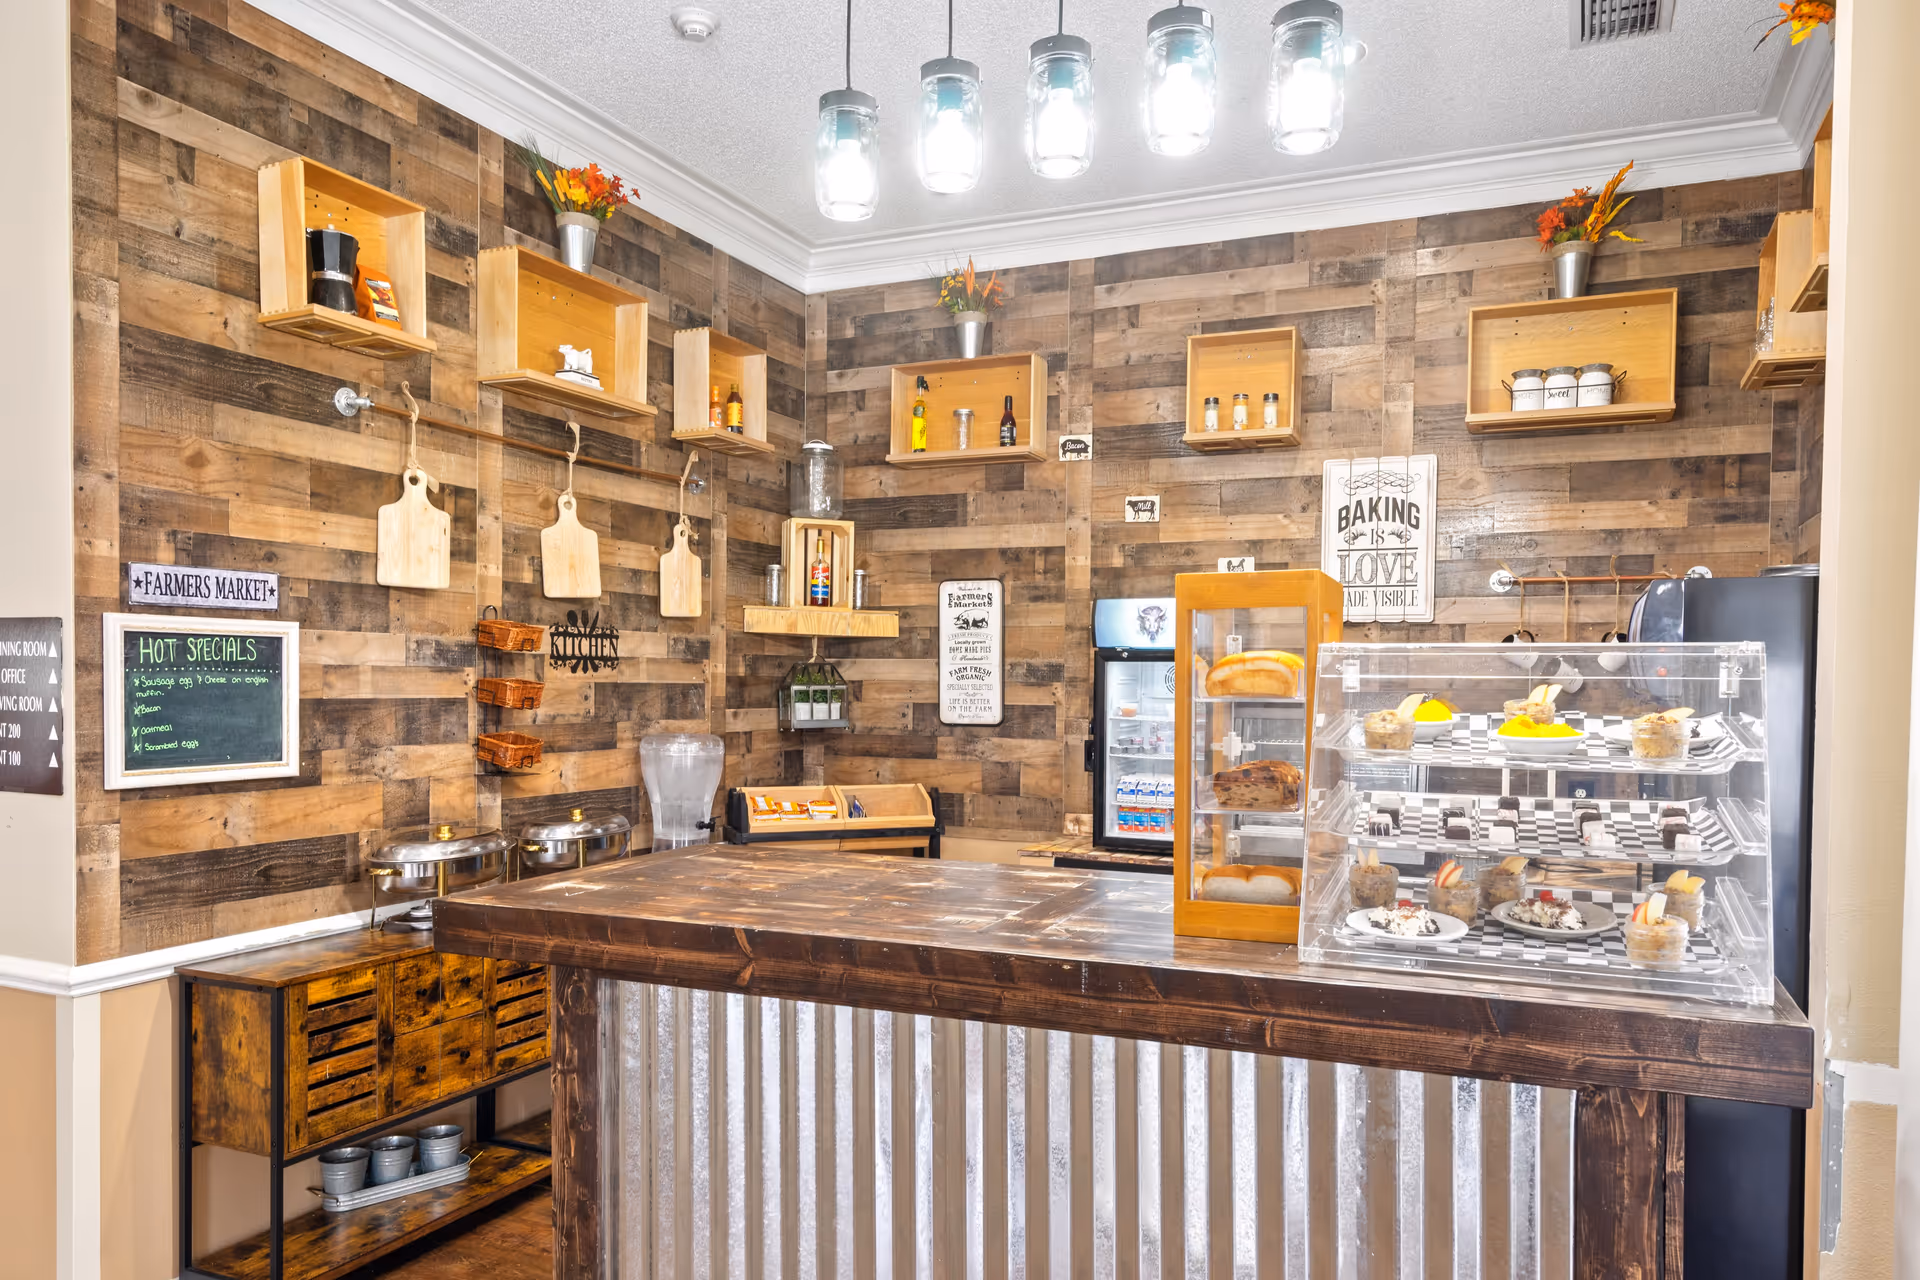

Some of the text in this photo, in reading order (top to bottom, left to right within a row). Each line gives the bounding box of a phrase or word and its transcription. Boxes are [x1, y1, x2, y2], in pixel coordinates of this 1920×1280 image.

[1547, 389, 1570, 399] Sweet
[1065, 441, 1085, 450] Bacon
[1134, 502, 1152, 510] Milk
[1338, 496, 1420, 533] BAKING
[1370, 528, 1385, 545] IS
[1337, 552, 1418, 584] LOVE
[144, 571, 268, 601] FARMERS MARKET
[1343, 589, 1418, 607] ADE VISIBLE
[23, 641, 47, 657] ROOM
[140, 637, 257, 663] HOT SPECIALS
[551, 634, 618, 659] KITCHEN
[1, 668, 26, 684] OFFICE
[949, 666, 991, 677] FARM FRESH
[141, 676, 175, 689] Sausage
[179, 677, 193, 689] egg
[19, 696, 43, 712] ROOM
[141, 704, 161, 714] Bacon
[8, 723, 21, 739] 200
[8, 750, 21, 766] 100
